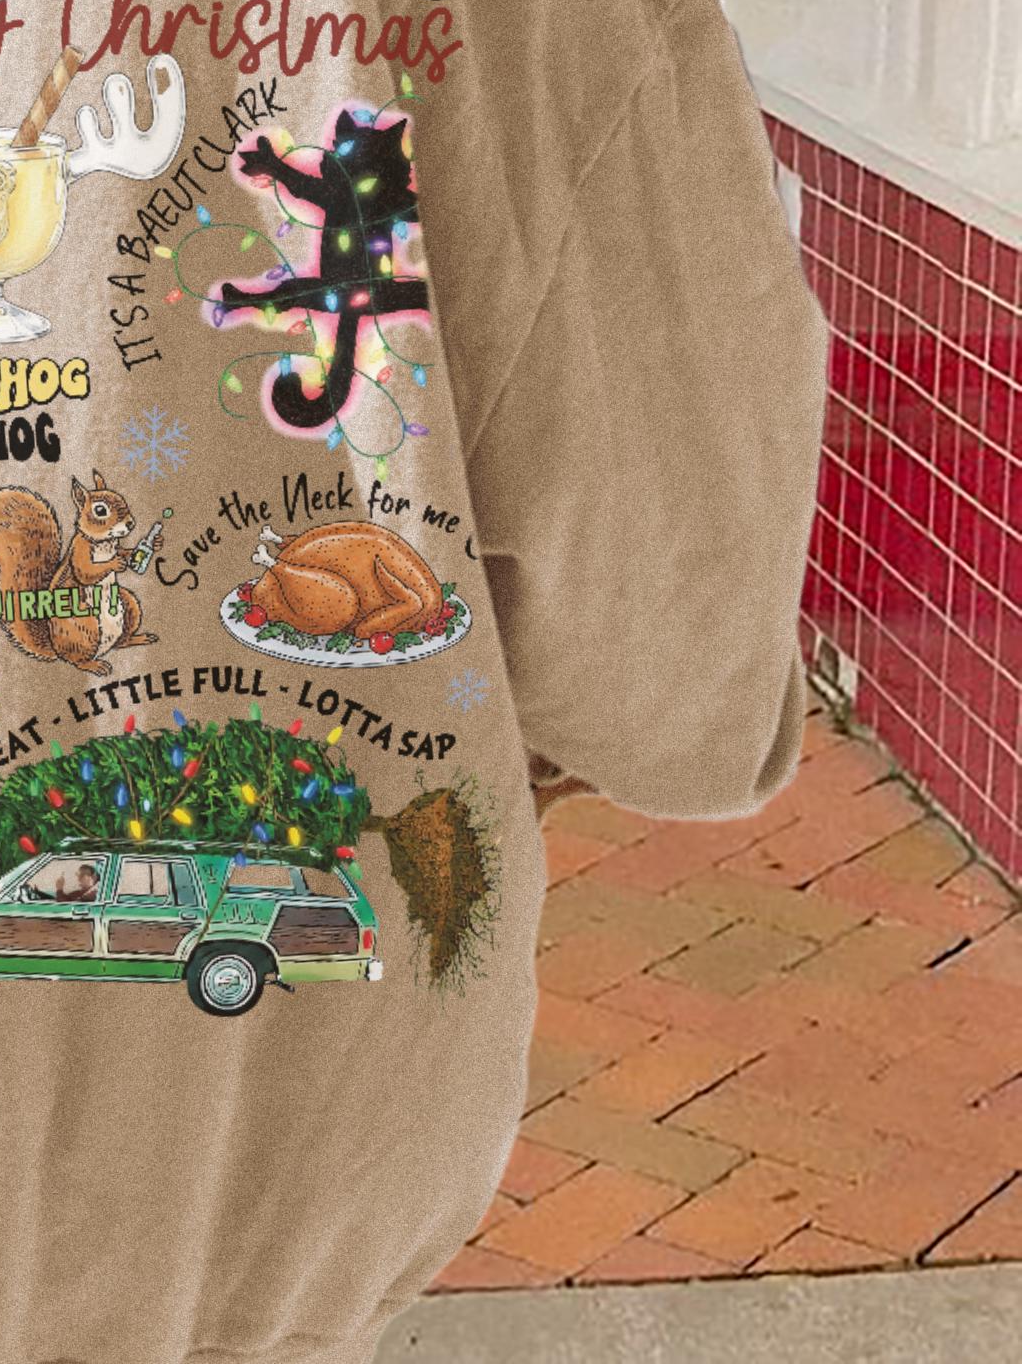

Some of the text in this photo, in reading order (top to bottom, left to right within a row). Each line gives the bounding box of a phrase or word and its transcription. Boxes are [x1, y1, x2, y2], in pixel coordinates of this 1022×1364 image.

[107, 77, 288, 372] IT'S A BAEUT CLARK
[155, 471, 461, 591] Save the Neck for me
[67, 672, 183, 724] LITTLE
[192, 665, 268, 697] FULL
[295, 679, 393, 752] LOTTA
[397, 729, 457, 761] SAP
